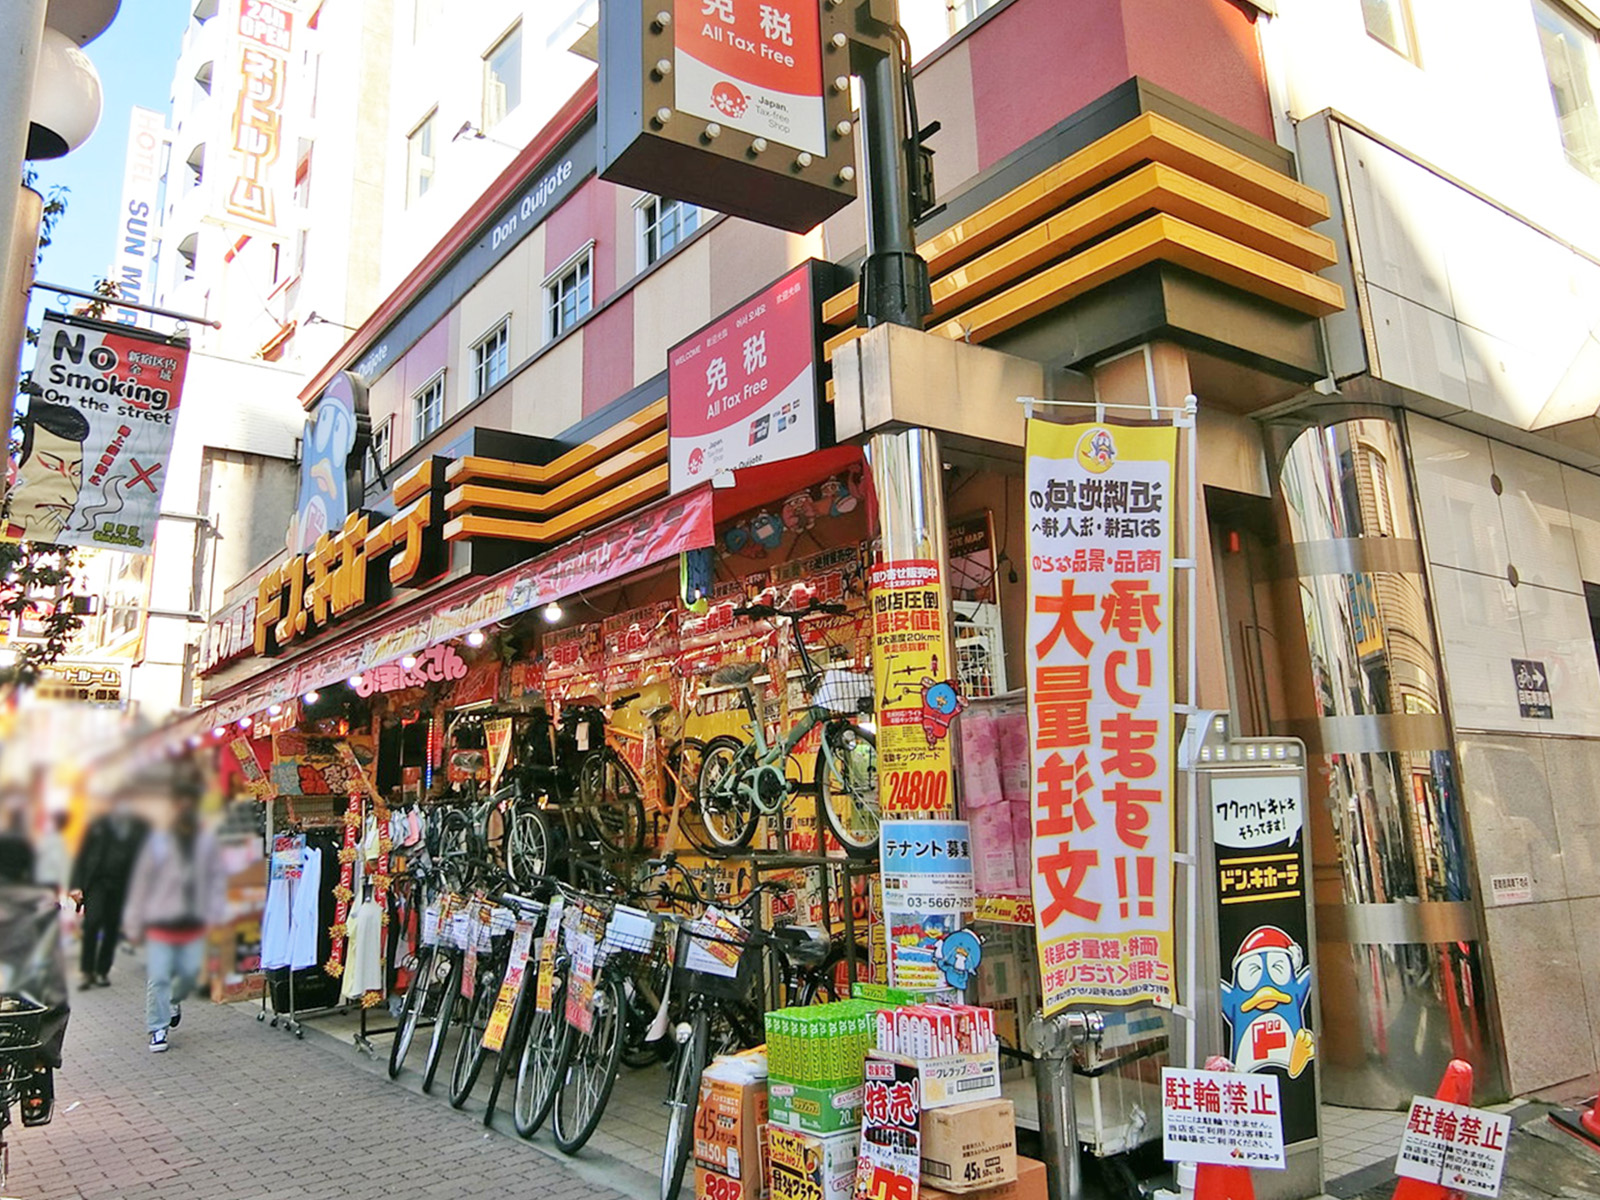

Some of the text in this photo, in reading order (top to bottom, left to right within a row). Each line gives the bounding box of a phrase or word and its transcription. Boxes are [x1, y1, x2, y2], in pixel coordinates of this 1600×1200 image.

[702, 23, 795, 68] All Tax Free
[768, 119, 790, 134] Shop
[132, 113, 158, 183] HOTEL
[492, 160, 573, 250] Don Quijote
[124, 199, 150, 256] SUN
[128, 350, 177, 370] 新宿区内
[674, 344, 701, 367] WELCOME
[706, 329, 768, 398] 免税
[49, 364, 170, 411] Smoking
[706, 378, 769, 421] All Tax Free
[45, 388, 173, 427] On the street
[875, 590, 939, 613] 他店圧倒
[887, 770, 948, 811] 24800
[1216, 797, 1296, 821] ワクワクドキドキ
[1238, 817, 1287, 841] そろってます!
[867, 1064, 893, 1077] 数量限定
[864, 1078, 920, 1124] 特売!
[1164, 1077, 1277, 1116] 駐輪禁止
[698, 1106, 716, 1141] 45
[1167, 1114, 1273, 1130] ここには駐輪できません。
[1168, 1124, 1273, 1139] 当店をご利用のお客様は
[1407, 1104, 1503, 1151] 駐輪禁止
[1167, 1133, 1273, 1149] 駐輪場をご利用ください。
[1404, 1144, 1496, 1171] 当店をご利用のお客様は
[1402, 1152, 1493, 1180] 駐輪場をご利用ください。
